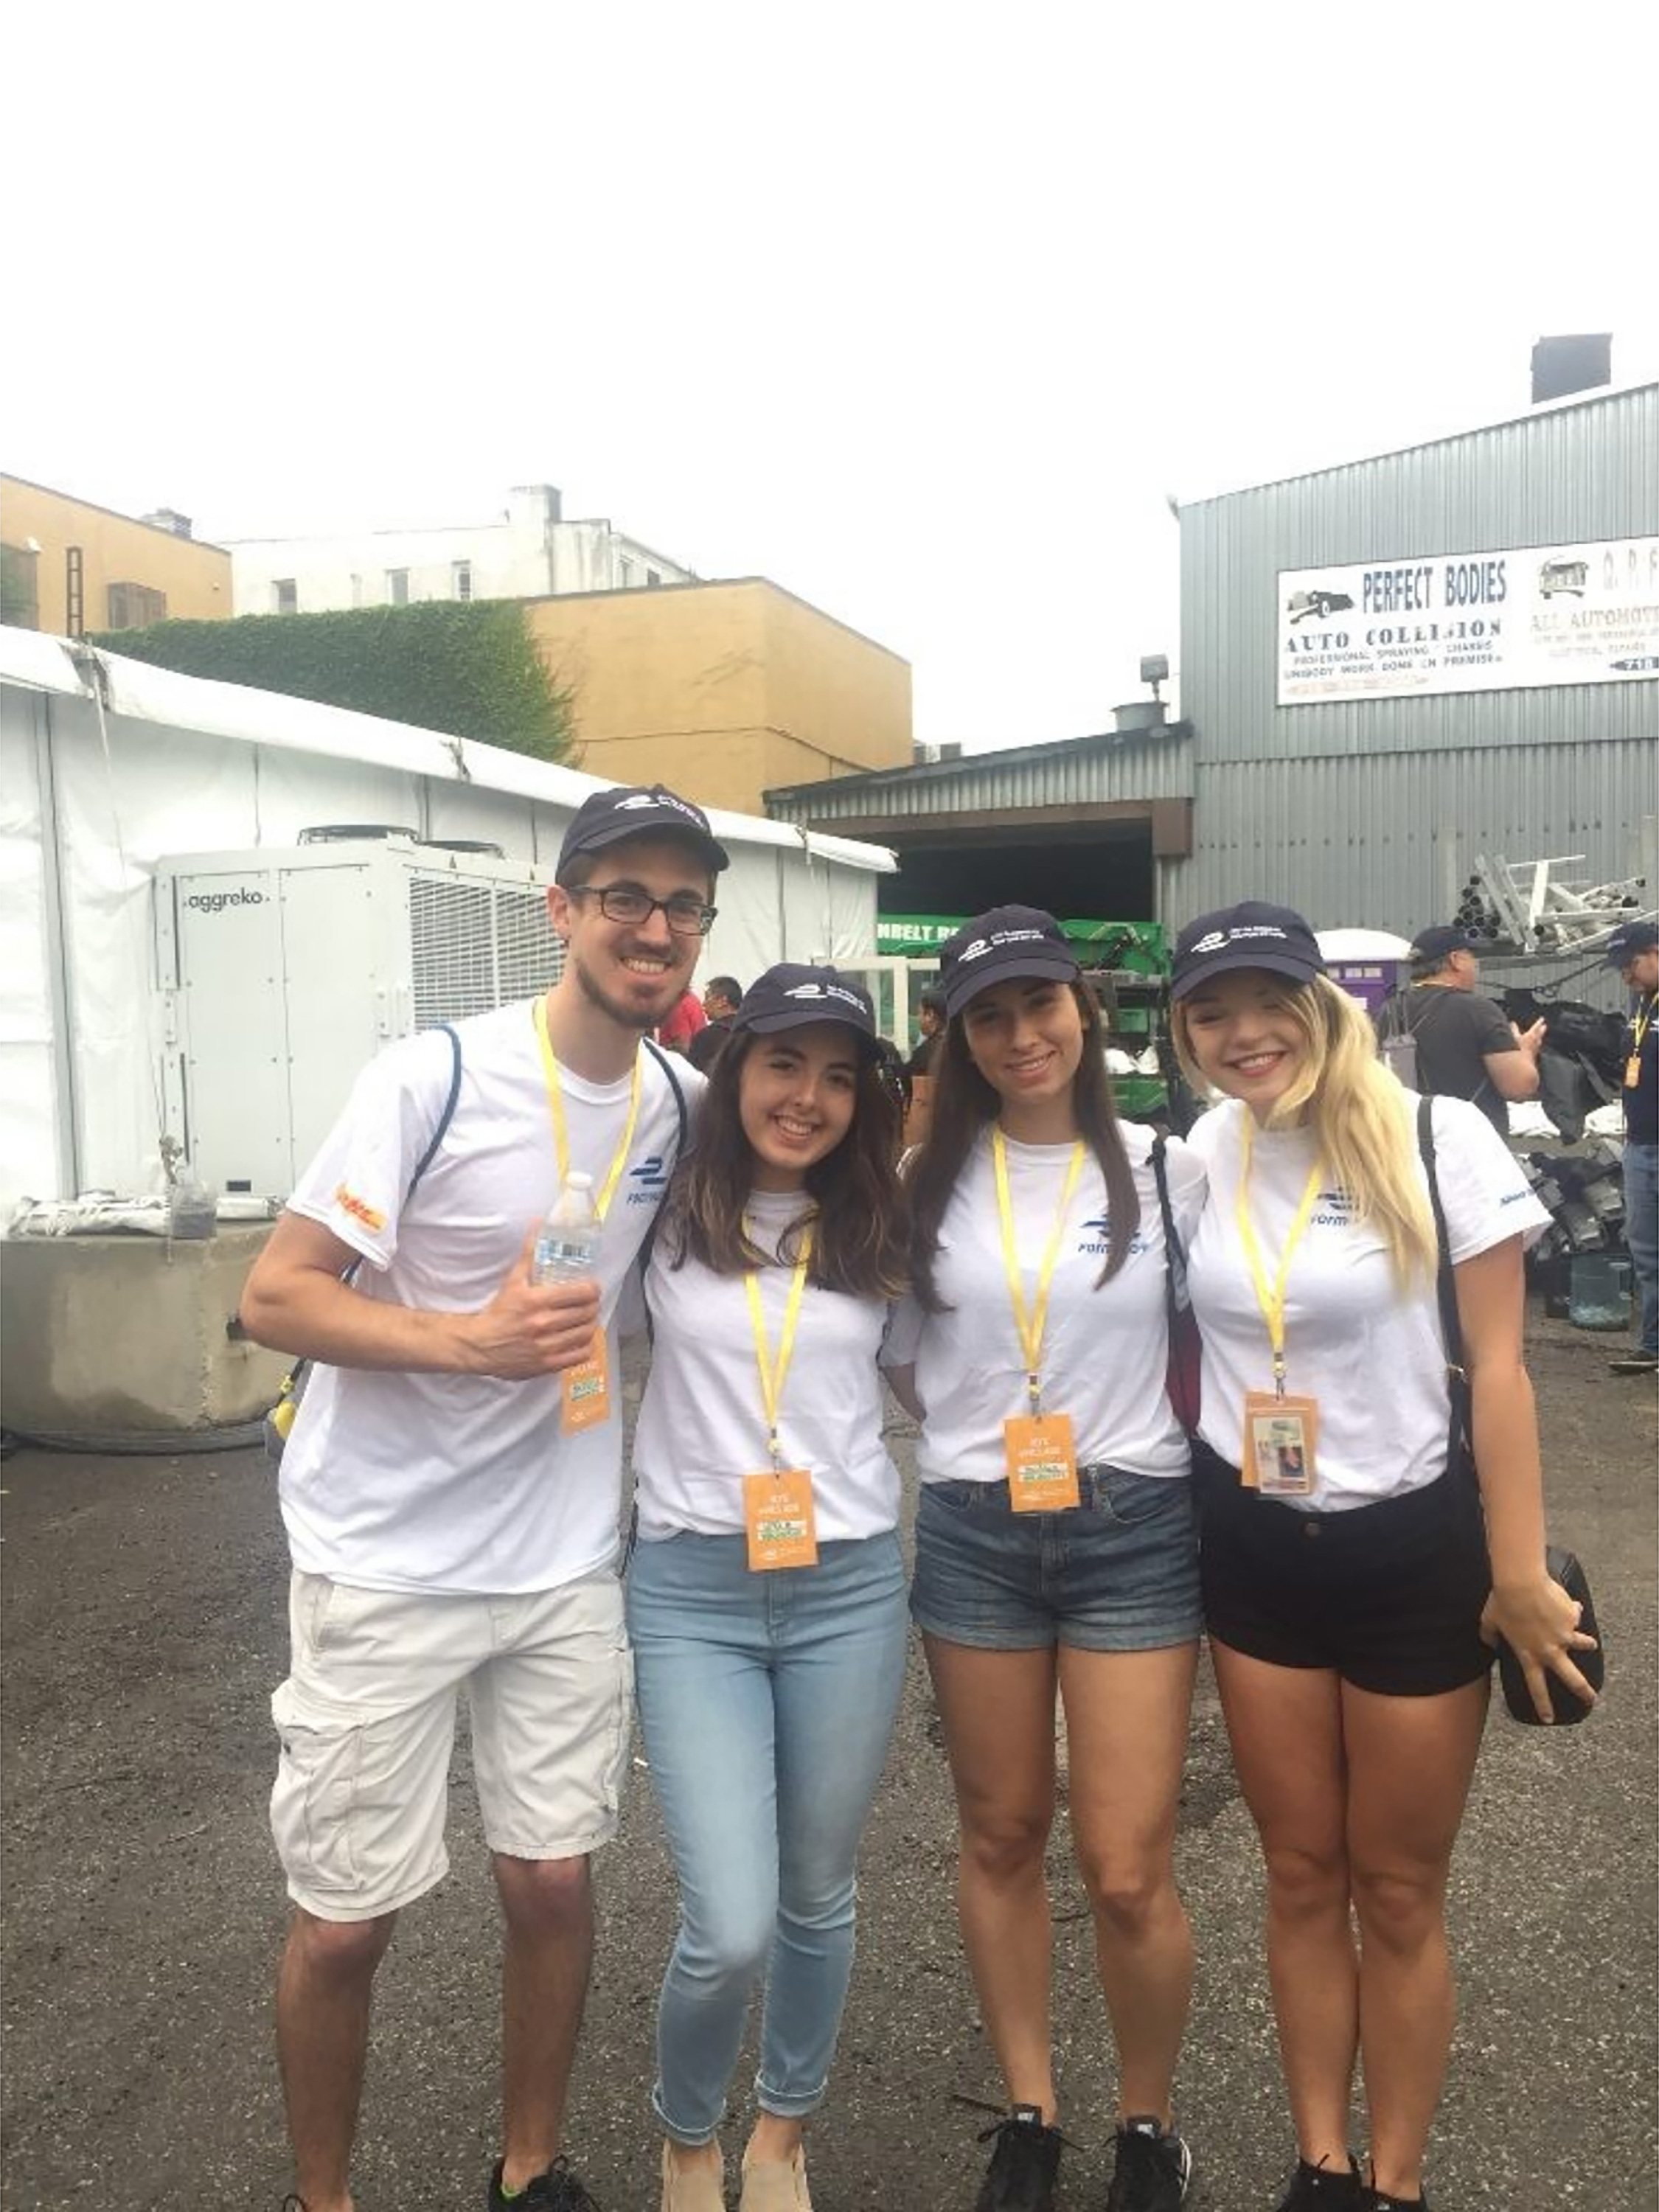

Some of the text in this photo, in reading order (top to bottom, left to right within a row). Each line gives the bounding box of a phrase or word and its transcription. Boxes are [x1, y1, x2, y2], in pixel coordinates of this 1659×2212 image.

[1363, 560, 1506, 613] PERFECT BODIES
[1287, 631, 1349, 653] AUTO
[188, 886, 262, 913] aggreko
